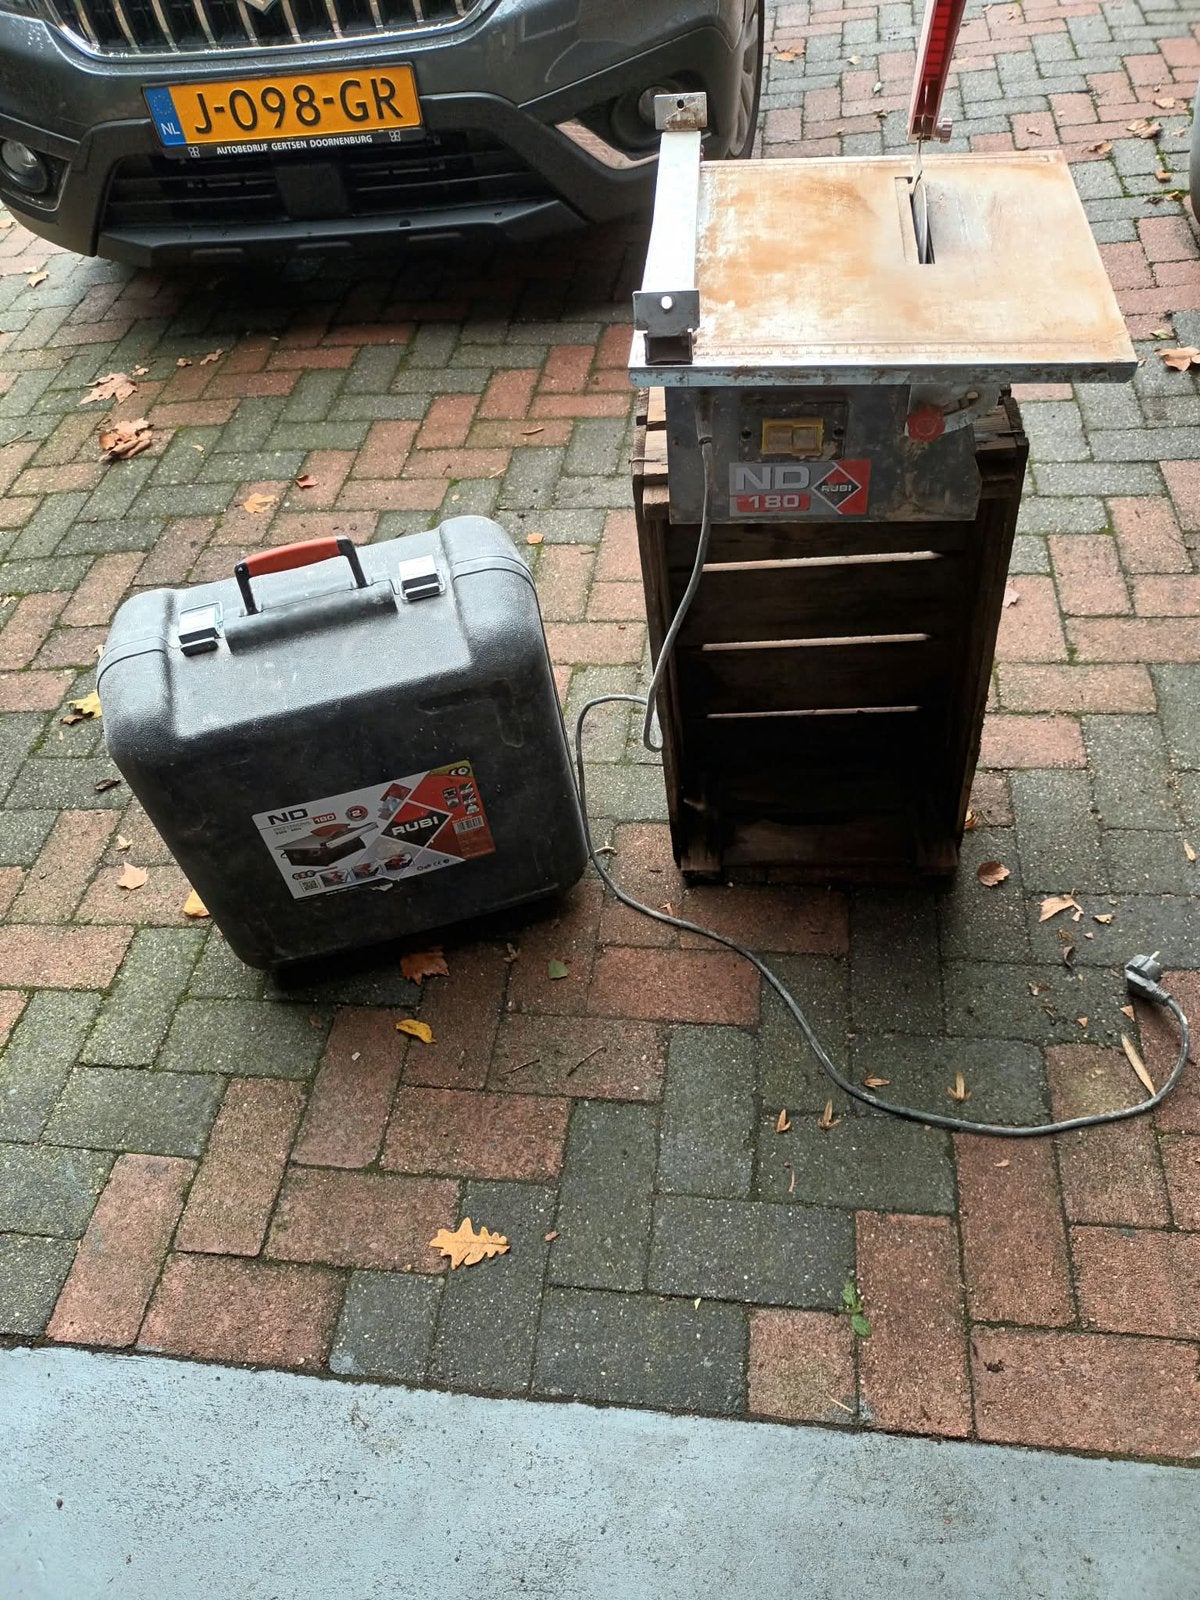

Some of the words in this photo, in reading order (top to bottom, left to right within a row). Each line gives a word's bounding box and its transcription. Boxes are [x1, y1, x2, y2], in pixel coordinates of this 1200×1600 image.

[194, 76, 404, 134] J-098-GR
[161, 122, 181, 136] NL
[216, 143, 268, 155] AUTOBEDRIJF
[271, 140, 307, 151] GERTSEN
[310, 135, 373, 148] DOORNENBURG
[735, 465, 811, 491] ND
[821, 483, 852, 493] RUBI
[748, 494, 800, 509] 180
[267, 808, 309, 826] ND
[314, 814, 335, 824] 180
[391, 816, 439, 836] RUBI
